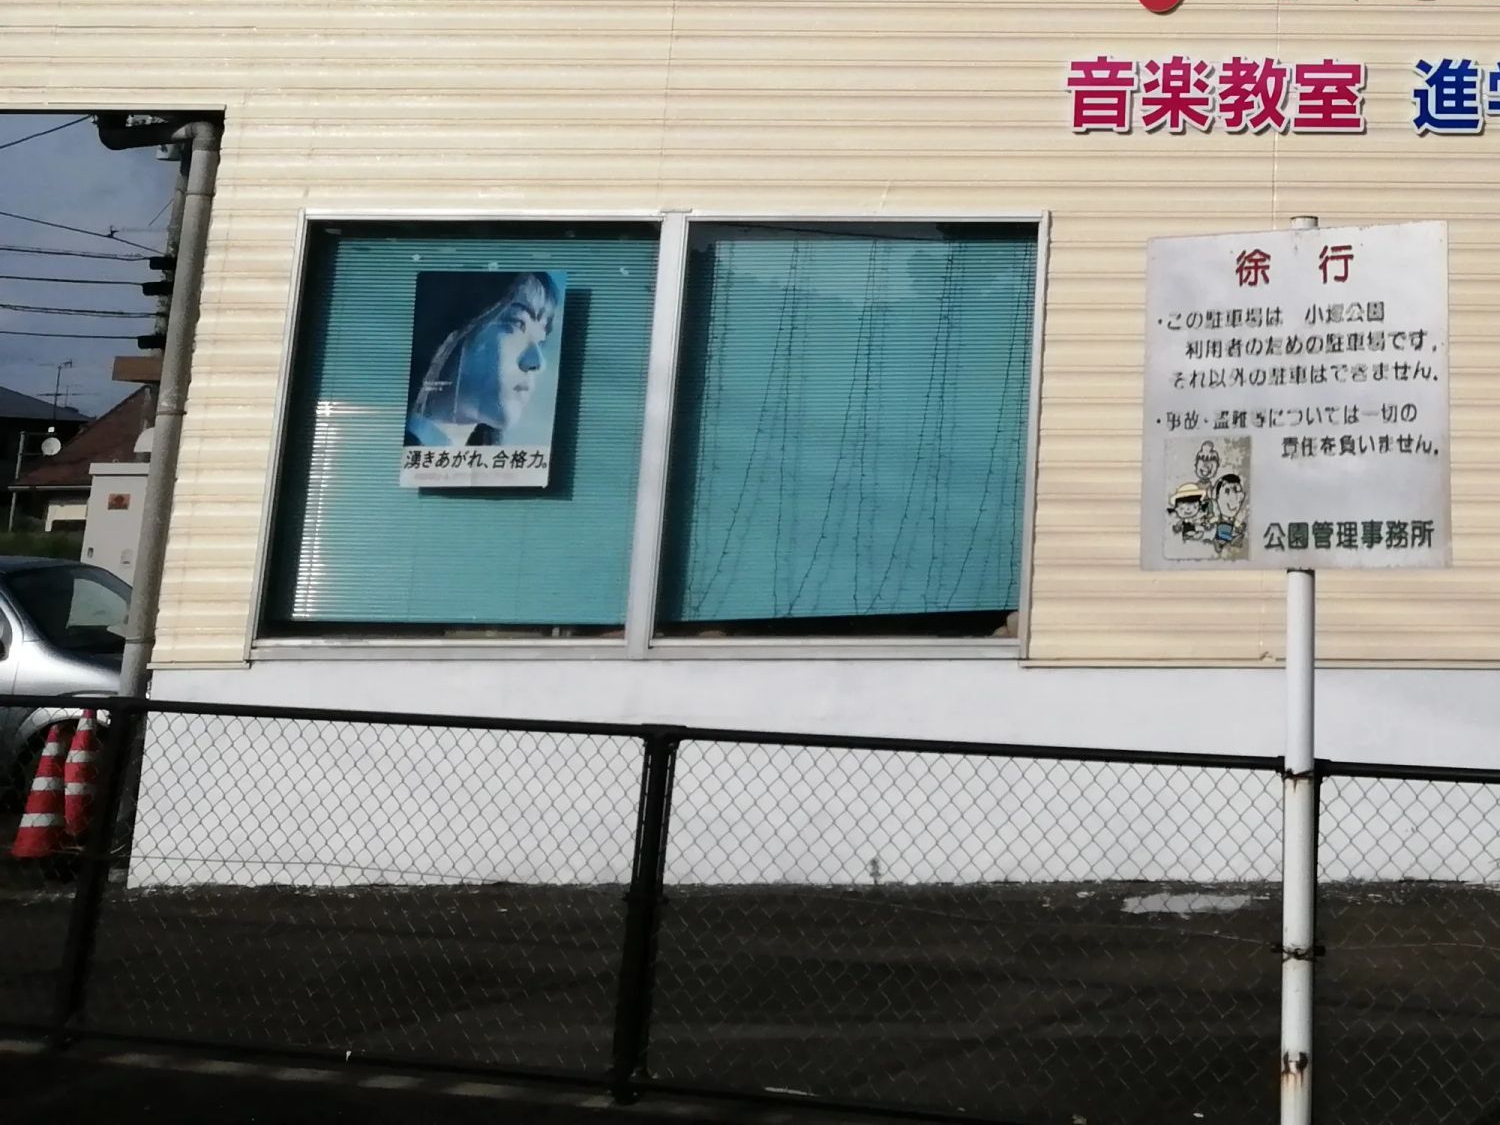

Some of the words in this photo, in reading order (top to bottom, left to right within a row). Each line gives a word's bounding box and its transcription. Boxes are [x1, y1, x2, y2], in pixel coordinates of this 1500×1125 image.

[1067, 56, 1365, 135] 音楽教室
[1235, 245, 1354, 287] 徐行
[404, 450, 547, 469] 湧きあがれ、合格力。
[1263, 519, 1435, 552] 公園管理事務所
